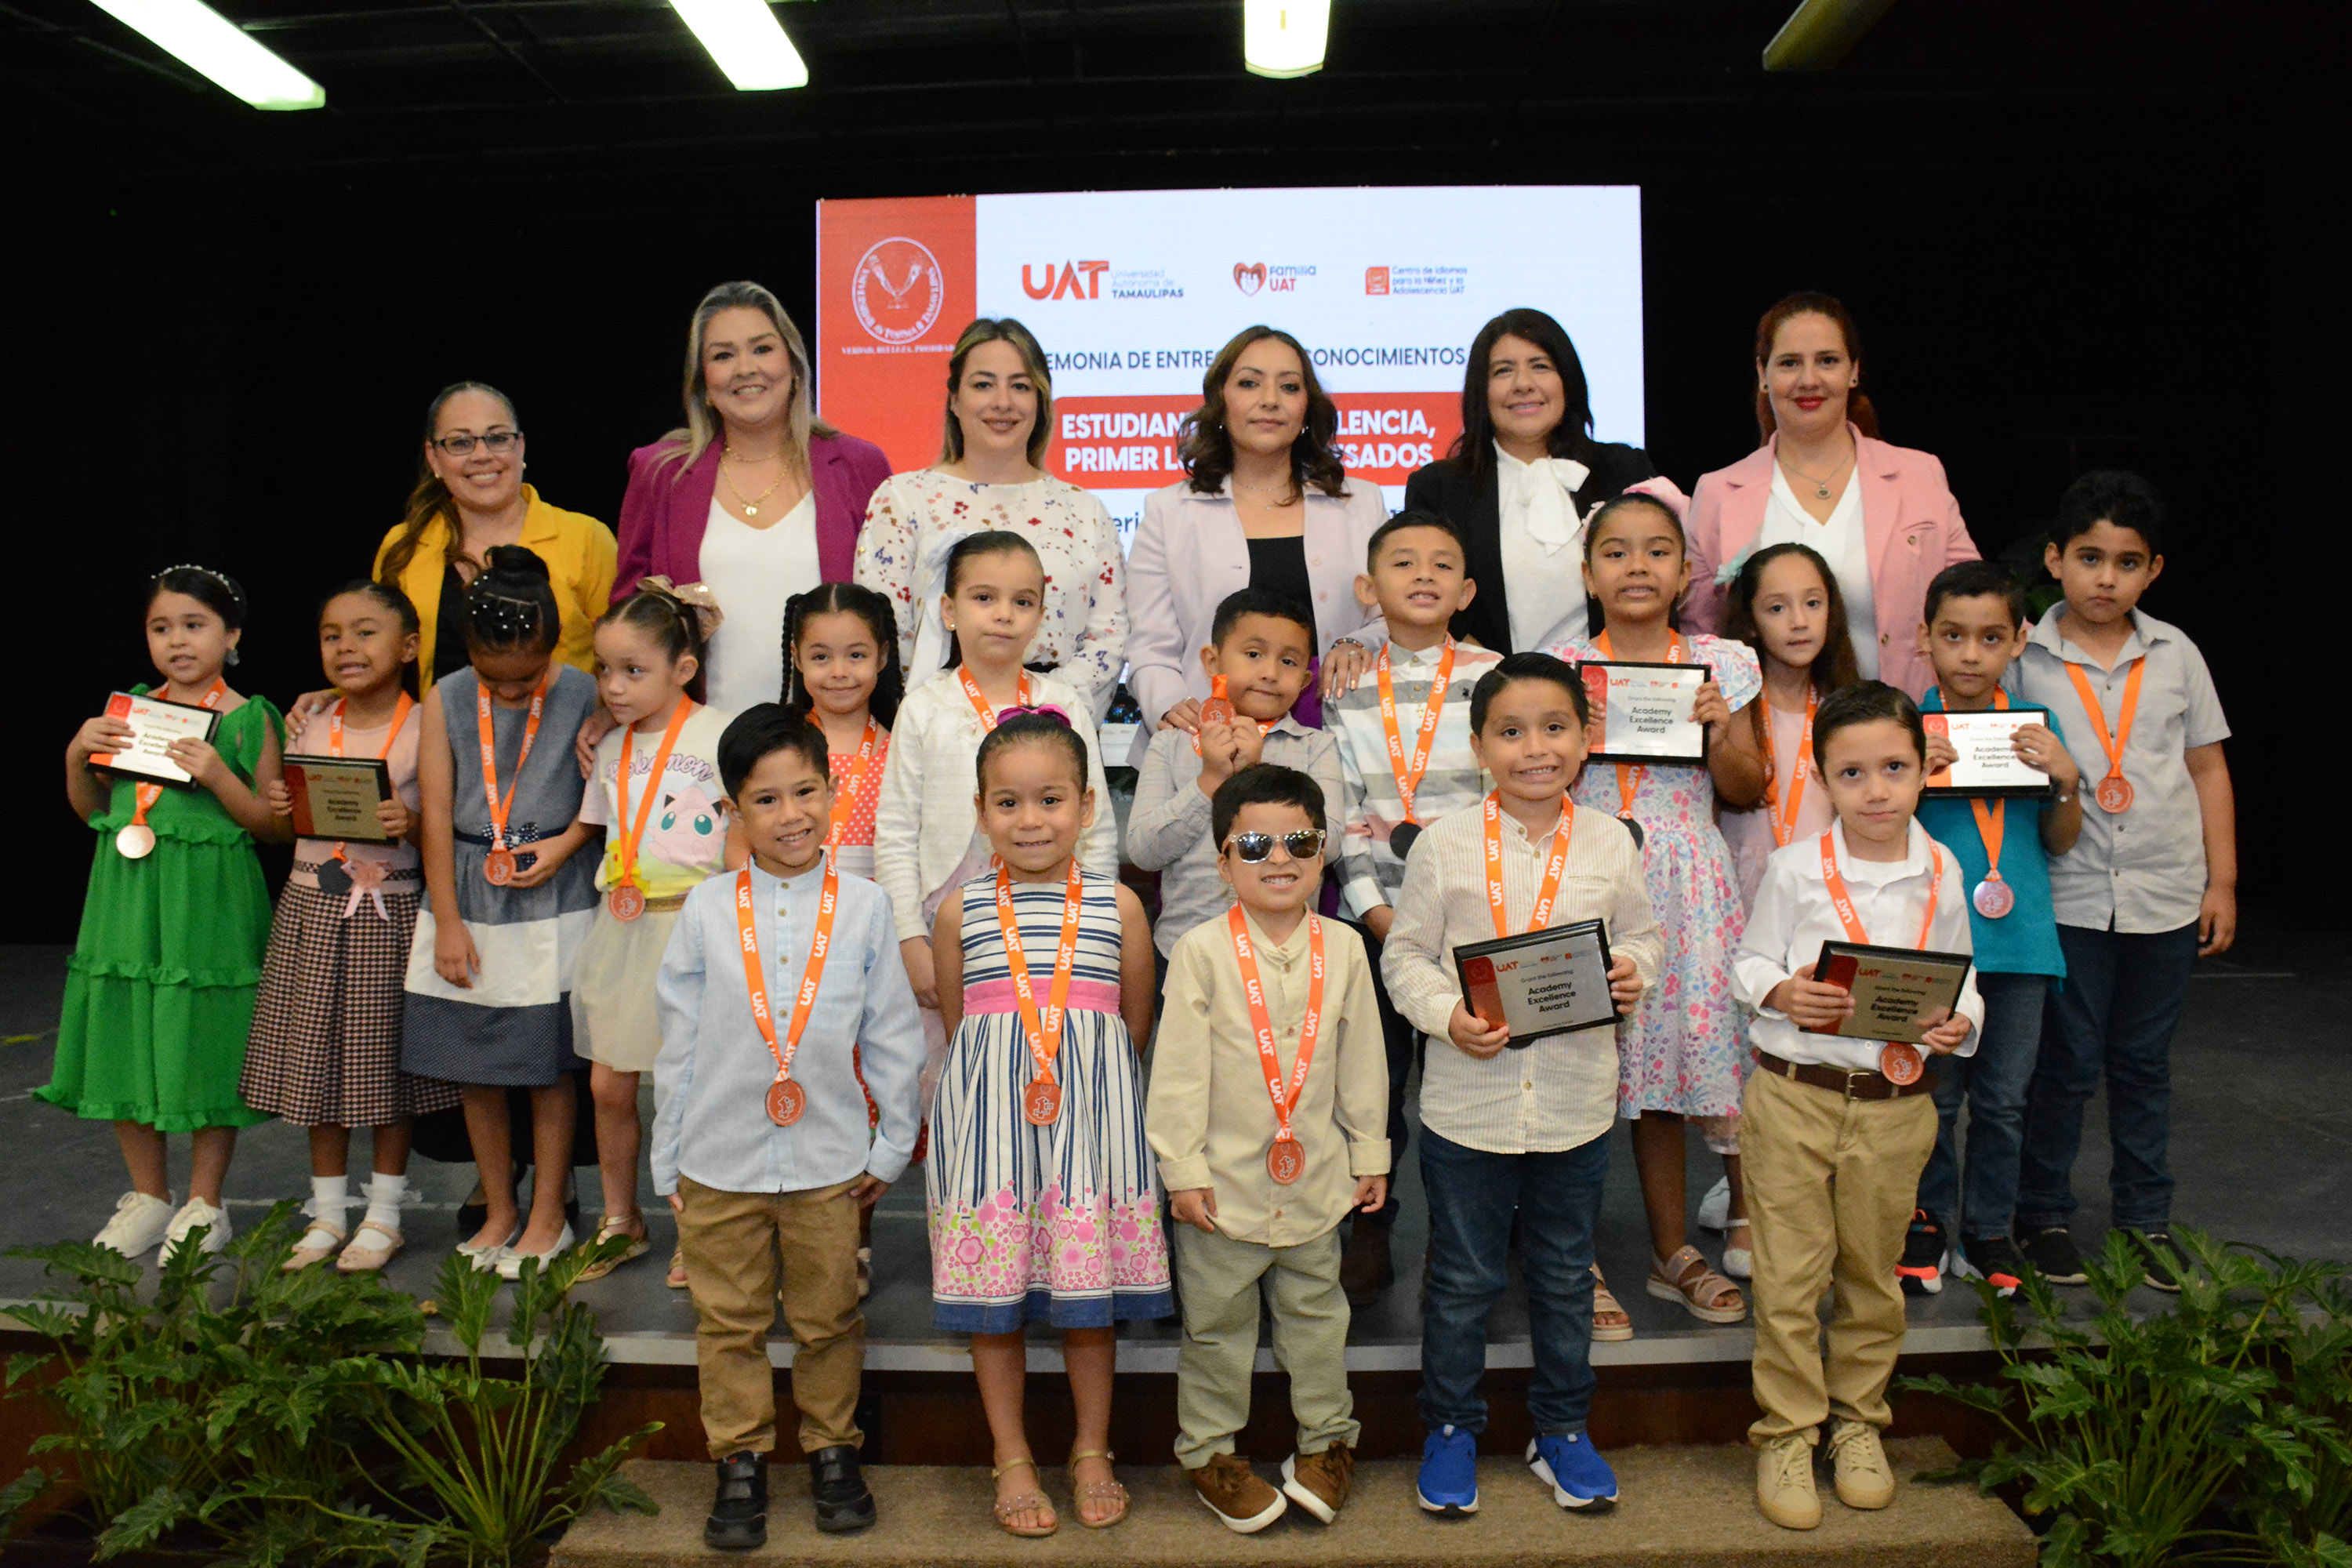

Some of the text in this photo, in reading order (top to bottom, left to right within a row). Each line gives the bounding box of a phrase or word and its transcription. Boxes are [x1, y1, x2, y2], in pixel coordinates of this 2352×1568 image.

[1022, 260, 1109, 300] UAT
[1270, 278, 1296, 292] UAT
[1112, 288, 1184, 299] TAMAULIPAS
[1128, 350, 1151, 368] DE
[1157, 350, 1219, 368] ENTRE
[1065, 445, 1160, 472] PRIMER
[964, 680, 981, 698] UAT
[1434, 673, 1447, 695] UAT
[982, 710, 998, 729] UAT
[1381, 697, 1393, 718] UAT
[1632, 706, 1671, 717] Academy
[1423, 709, 1437, 732] UAT
[1629, 716, 1674, 725] Excellence
[483, 743, 493, 766] UAT
[860, 741, 872, 760] UAT
[1388, 735, 1402, 758] UAT
[1414, 748, 1427, 772] UAT
[1796, 756, 1807, 780] UAT
[486, 782, 496, 804] UAT
[848, 774, 861, 796] UAT
[1486, 800, 1497, 821] UAT
[831, 821, 843, 844] UAT
[1560, 815, 1571, 840] UAT
[1487, 837, 1499, 862] UAT
[1072, 860, 1082, 885] UAT
[1548, 855, 1563, 881] UAT
[1823, 857, 1835, 880] UAT
[739, 886, 750, 909] UAT
[822, 891, 834, 914] UAT
[997, 885, 1010, 907] UAT
[1490, 880, 1502, 907] UAT
[1067, 899, 1078, 924] UAT
[1535, 898, 1552, 925] UAT
[1835, 898, 1853, 924] UAT
[742, 927, 756, 953] UAT
[814, 931, 828, 957] UAT
[1005, 926, 1020, 953] UAT
[1236, 933, 1251, 959] UAT
[1059, 942, 1073, 971] UAT
[1313, 952, 1323, 979] UAT
[1496, 960, 1519, 972] UAT
[800, 978, 816, 1006] UAT
[1015, 973, 1032, 1000] UAT
[1247, 979, 1263, 1007] UAT
[1527, 991, 1577, 1005] Excellence
[1528, 982, 1572, 996] Academy
[752, 991, 768, 1019] UAT
[1538, 1000, 1570, 1013] Award
[1047, 1004, 1061, 1033] UAT
[1305, 1008, 1318, 1037] UAT
[1029, 1032, 1045, 1060] UAT
[1258, 1028, 1274, 1057] UAT
[1294, 1058, 1307, 1086] UAT
[1269, 1078, 1284, 1105] UAT
